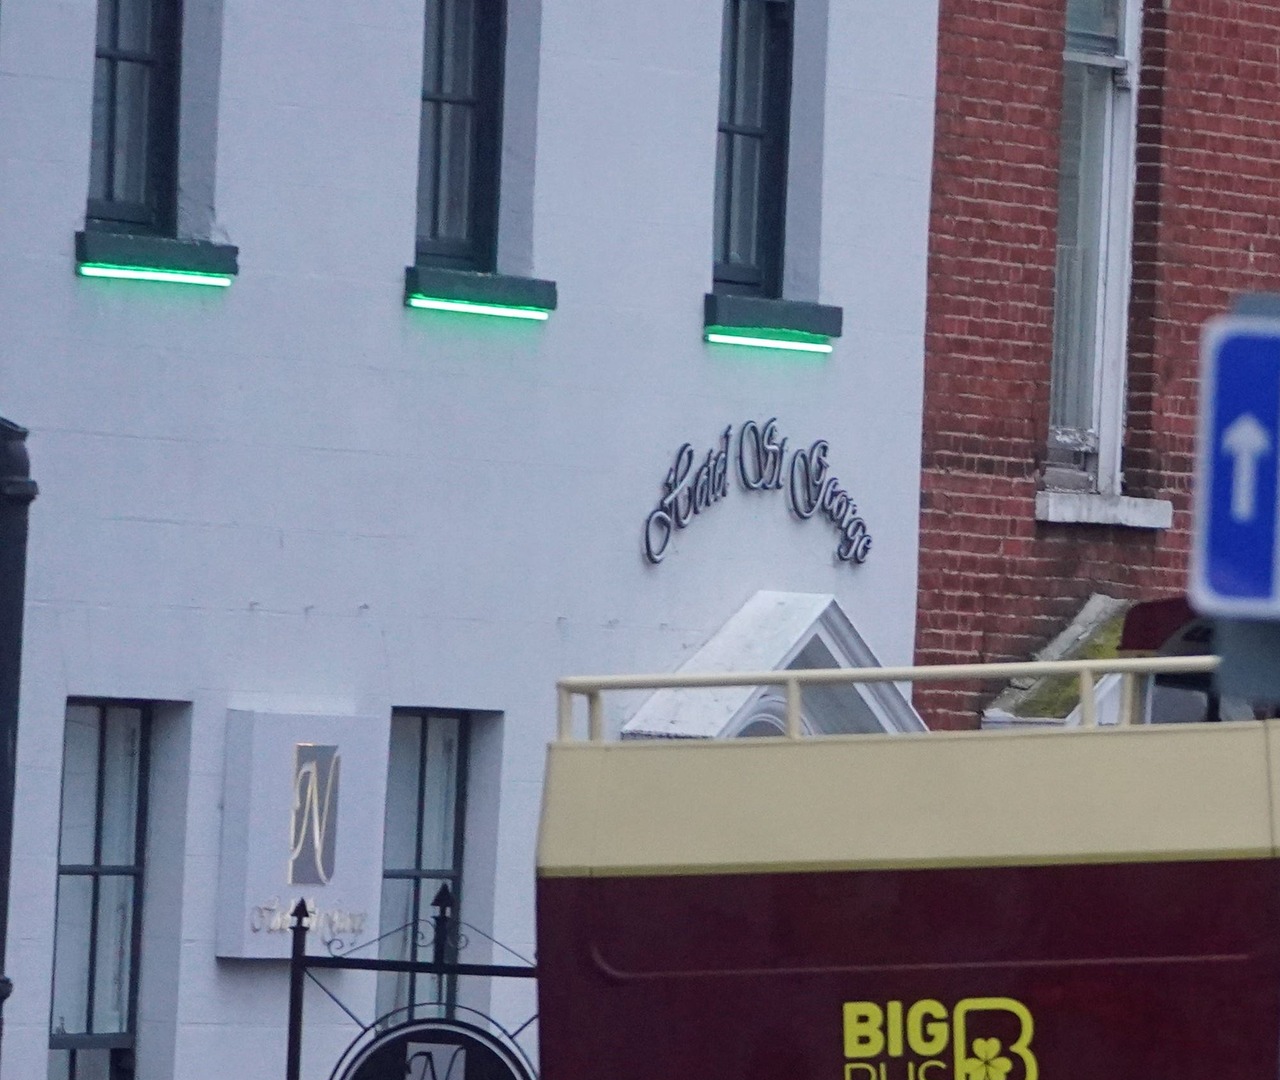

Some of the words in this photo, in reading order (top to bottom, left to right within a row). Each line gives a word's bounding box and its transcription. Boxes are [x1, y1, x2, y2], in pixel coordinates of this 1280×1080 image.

[646, 423, 732, 563] Hotel
[738, 417, 788, 489] St
[791, 440, 871, 563] George
[843, 999, 949, 1058] BIG
